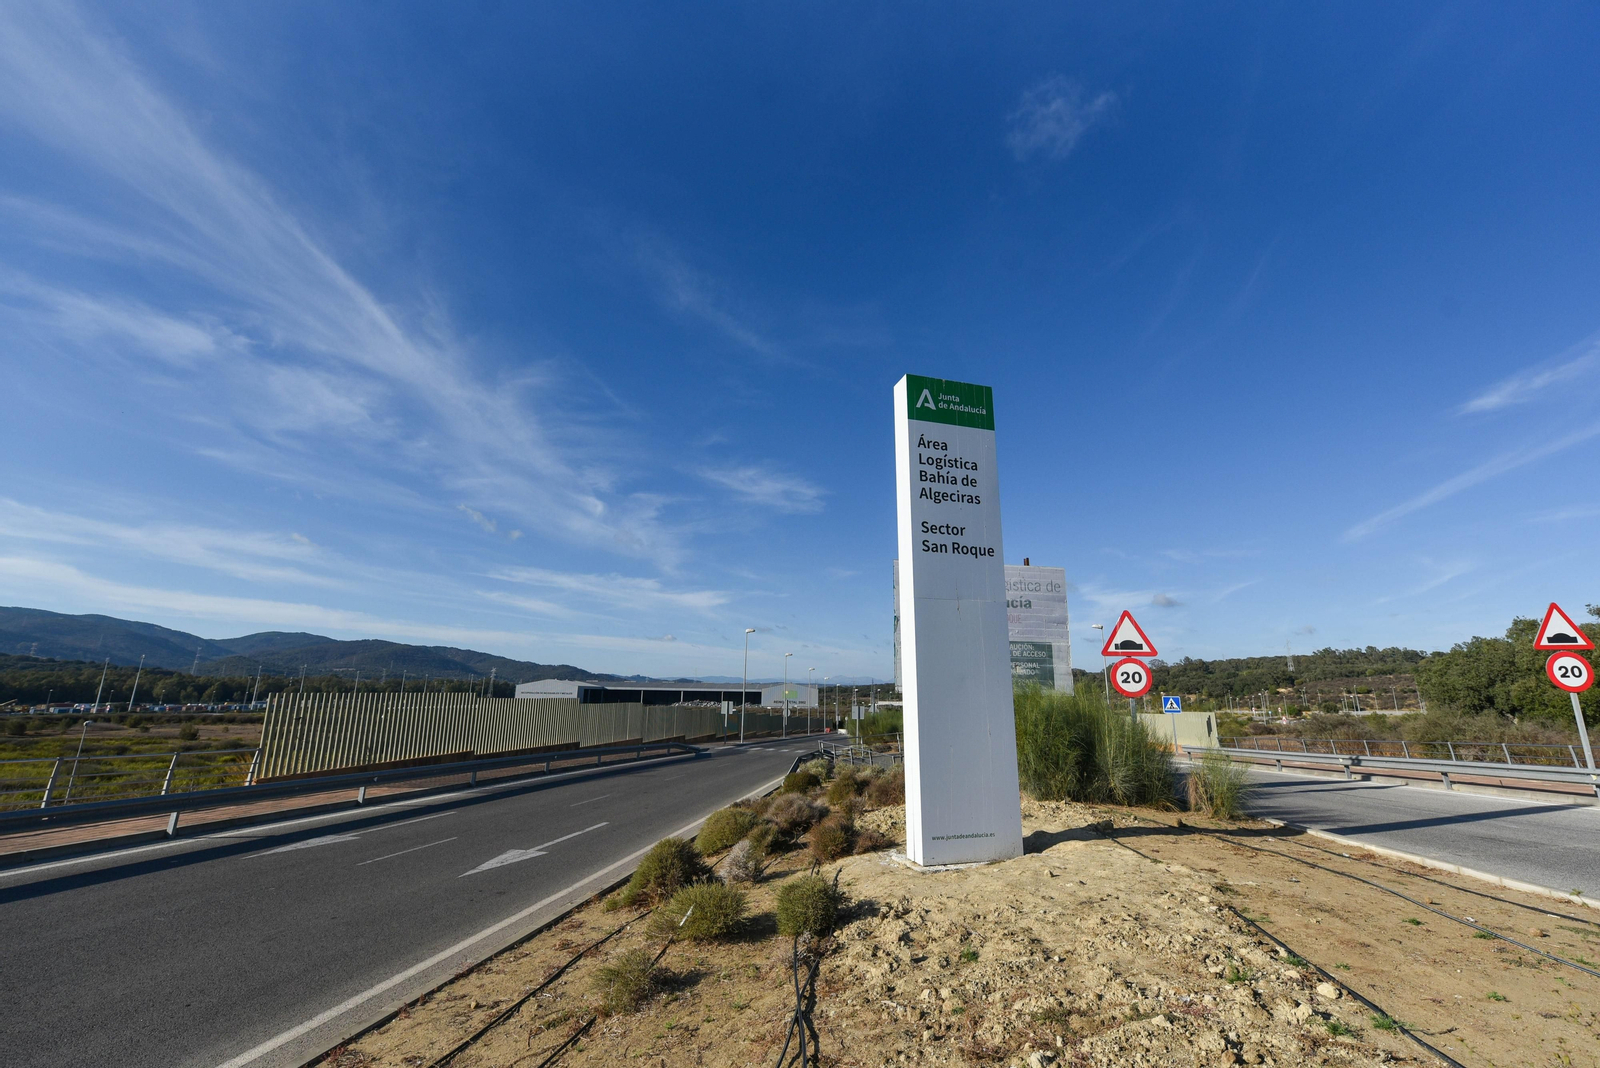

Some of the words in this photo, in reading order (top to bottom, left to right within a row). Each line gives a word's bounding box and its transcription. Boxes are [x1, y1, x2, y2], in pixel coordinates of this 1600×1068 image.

[938, 393, 960, 402] Junta
[938, 401, 948, 409] de
[949, 403, 987, 415] Andalucía
[917, 433, 948, 451] Área
[918, 453, 978, 471] Logística
[919, 470, 958, 486] Bahía
[961, 474, 977, 487] de
[919, 487, 981, 505] Algeciras
[921, 521, 966, 536] Sector
[922, 540, 948, 554] San
[952, 542, 995, 559] Roque
[1046, 579, 1061, 593] de
[1120, 671, 1143, 684] 20
[1558, 665, 1583, 678] 20
